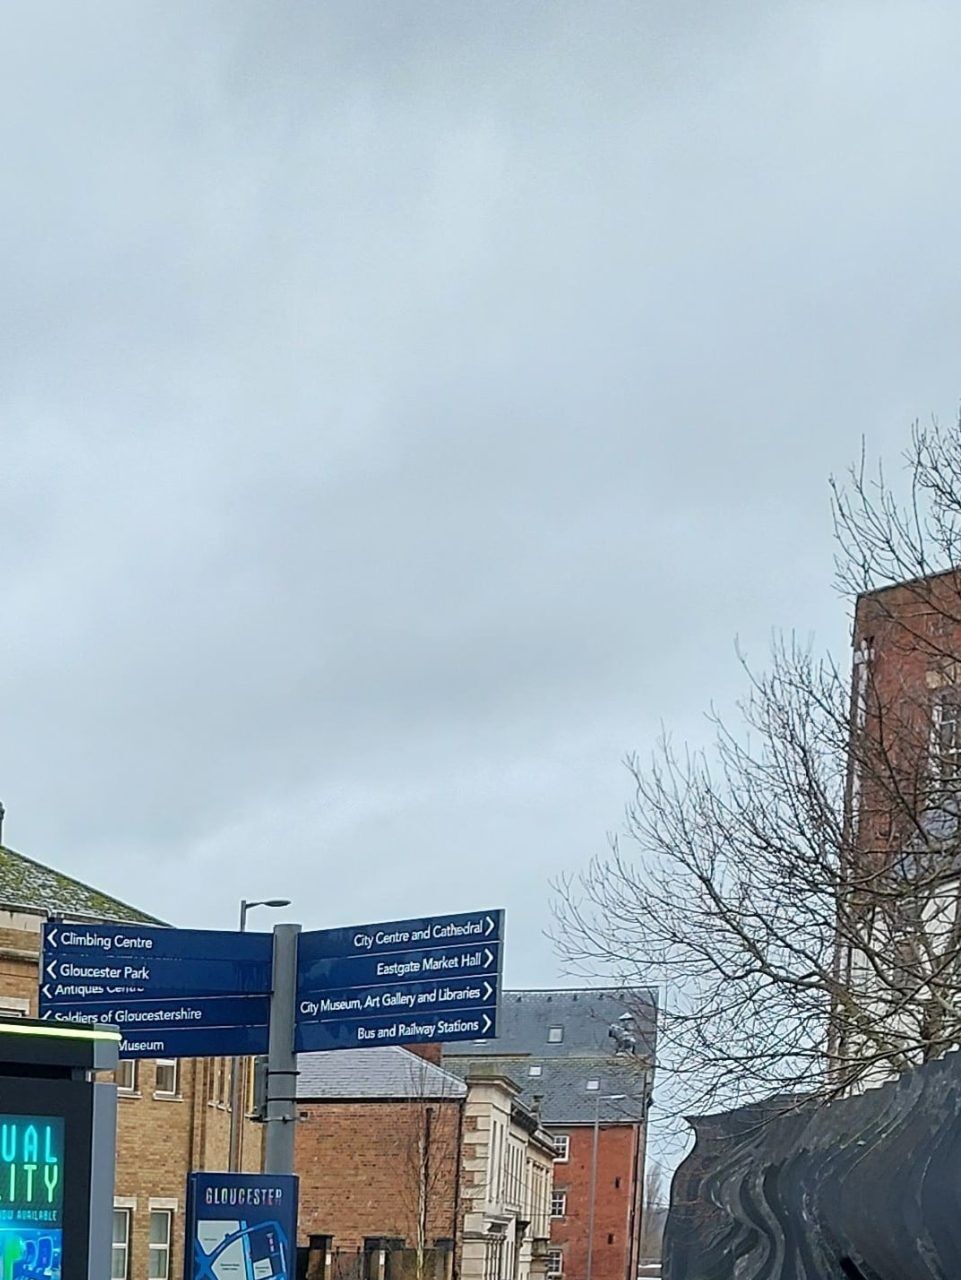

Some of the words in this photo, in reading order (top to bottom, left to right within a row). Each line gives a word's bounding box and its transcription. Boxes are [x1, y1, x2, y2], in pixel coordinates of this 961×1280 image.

[61, 932, 112, 950] Climbing
[114, 935, 153, 949] Centre
[354, 935, 374, 949] City
[375, 931, 410, 944] Centre
[411, 925, 431, 941] and
[433, 920, 483, 938] Cathedral
[60, 964, 121, 979] Gloucester
[124, 966, 150, 980] Park
[377, 962, 420, 977] Eastgate
[422, 957, 459, 971] Market
[461, 953, 482, 967] Hall
[54, 985, 104, 997] Antiques
[300, 1001, 319, 1016] City
[320, 999, 363, 1013] Museum,
[364, 995, 381, 1008] Art
[382, 992, 416, 1008] Gallery
[417, 989, 437, 1002] and
[438, 987, 481, 1001] Libraries
[54, 1012, 98, 1024] Soldiers
[100, 1011, 113, 1023] of
[115, 1008, 202, 1023] Gloucestershire
[358, 1027, 376, 1040] Bus
[377, 1025, 396, 1038] and
[398, 1023, 436, 1038] Railway
[437, 1019, 479, 1034] Stations
[118, 1040, 164, 1051] Museum
[205, 1187, 282, 1206] GLOUCESTER
[16, 1209, 57, 1222] AVAILABLE
